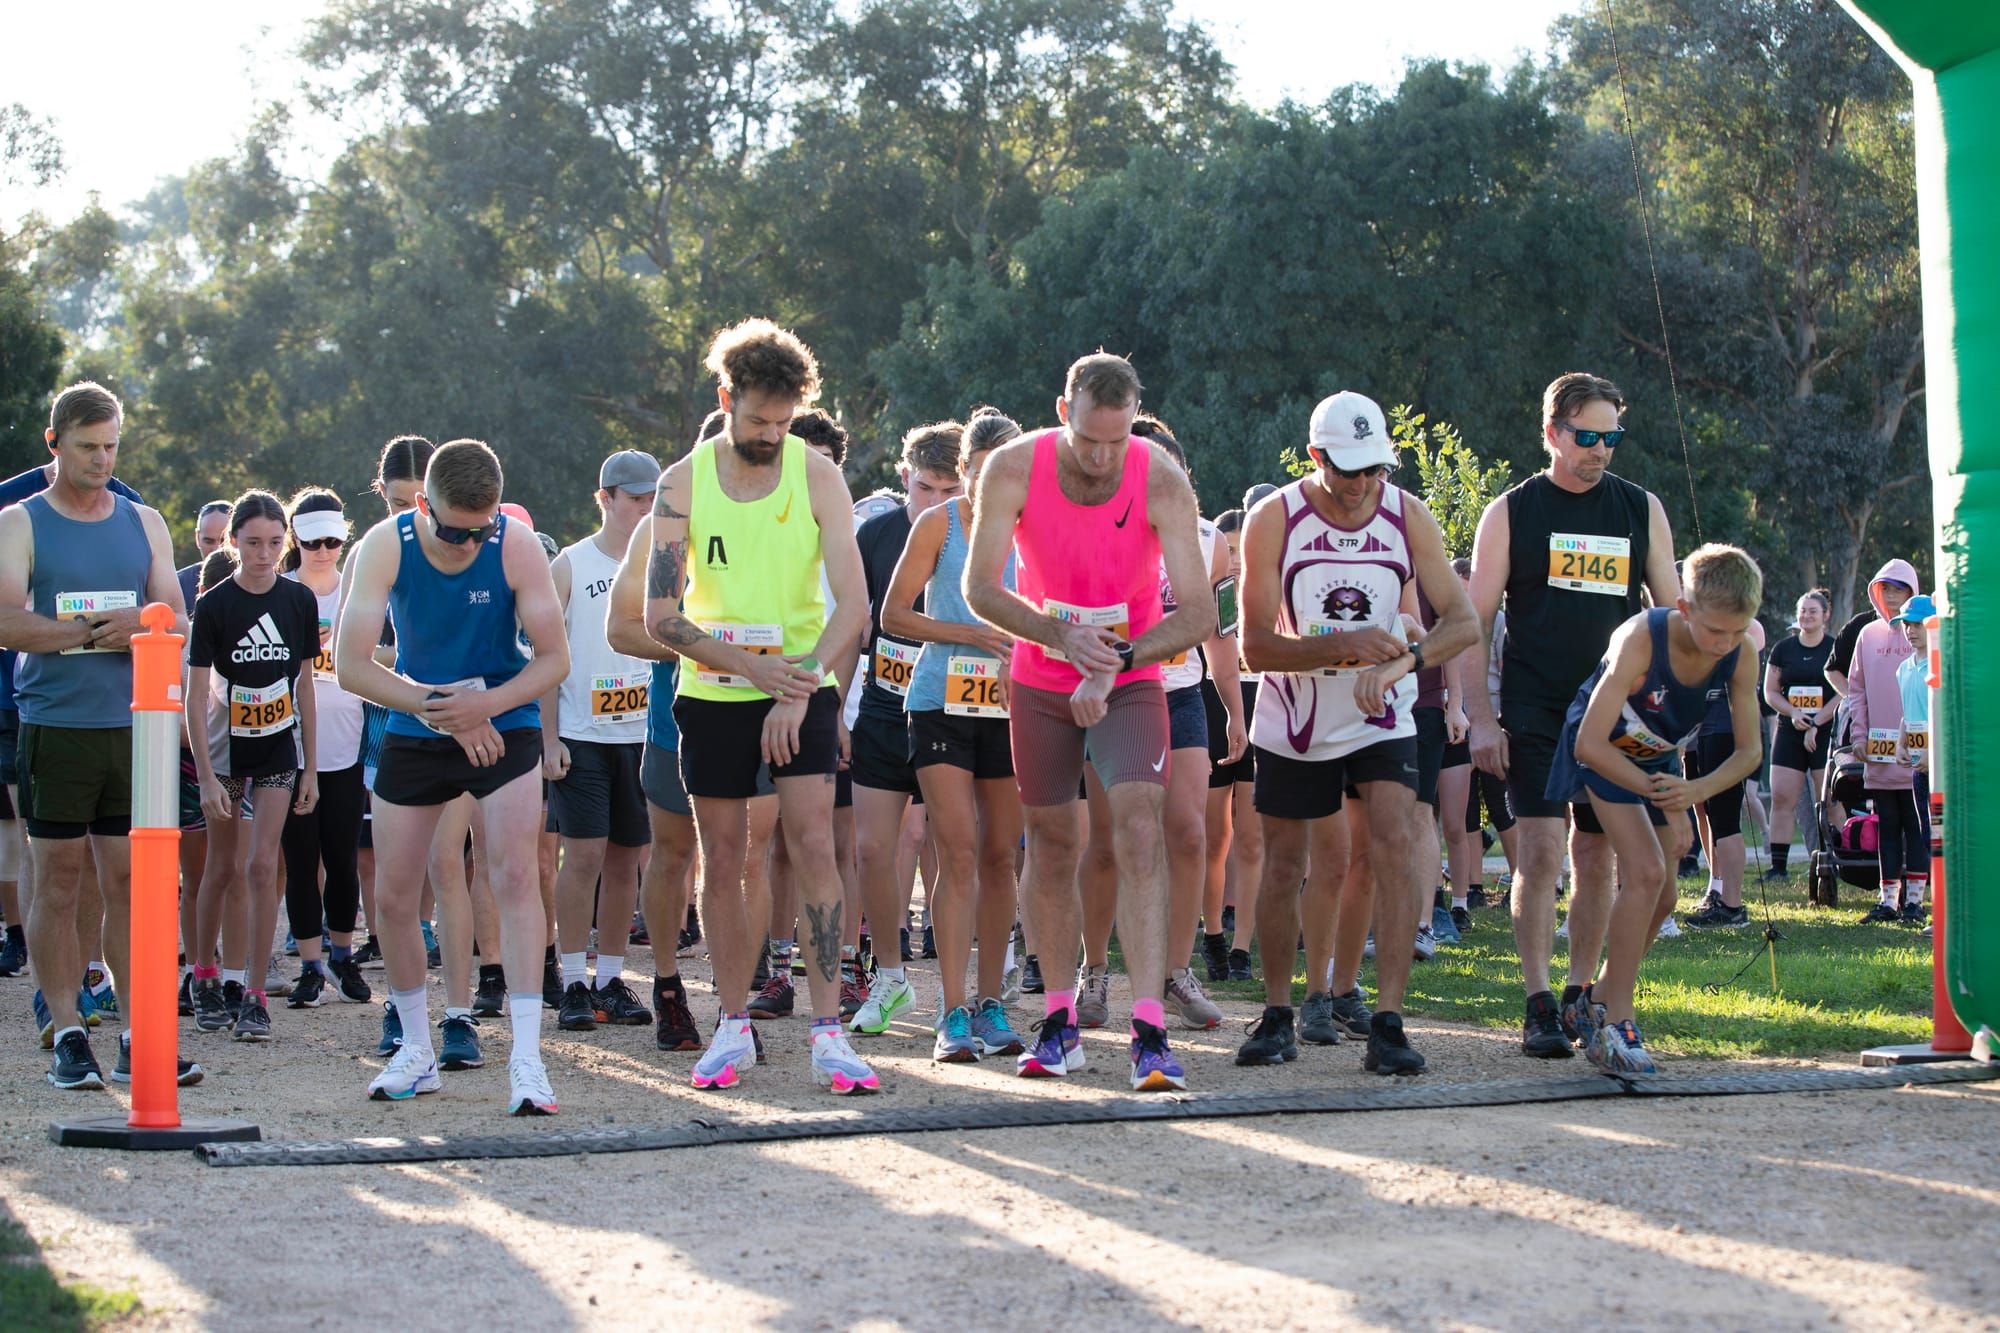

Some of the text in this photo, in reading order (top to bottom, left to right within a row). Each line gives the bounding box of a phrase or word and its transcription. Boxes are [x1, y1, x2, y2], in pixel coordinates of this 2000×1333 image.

[1338, 538, 1359, 548] STR
[1556, 539, 1587, 551] RUN
[1561, 553, 1617, 581] 2146
[62, 599, 95, 611] RUN
[231, 643, 290, 663] adidas
[880, 644, 904, 660] RUN
[954, 662, 986, 675] RUN
[596, 678, 624, 689] RUN
[235, 691, 262, 703] RUN
[600, 686, 648, 713] 2202
[1792, 696, 1818, 708] 2126
[240, 698, 285, 726] 2189
[1871, 741, 1895, 755] 202
